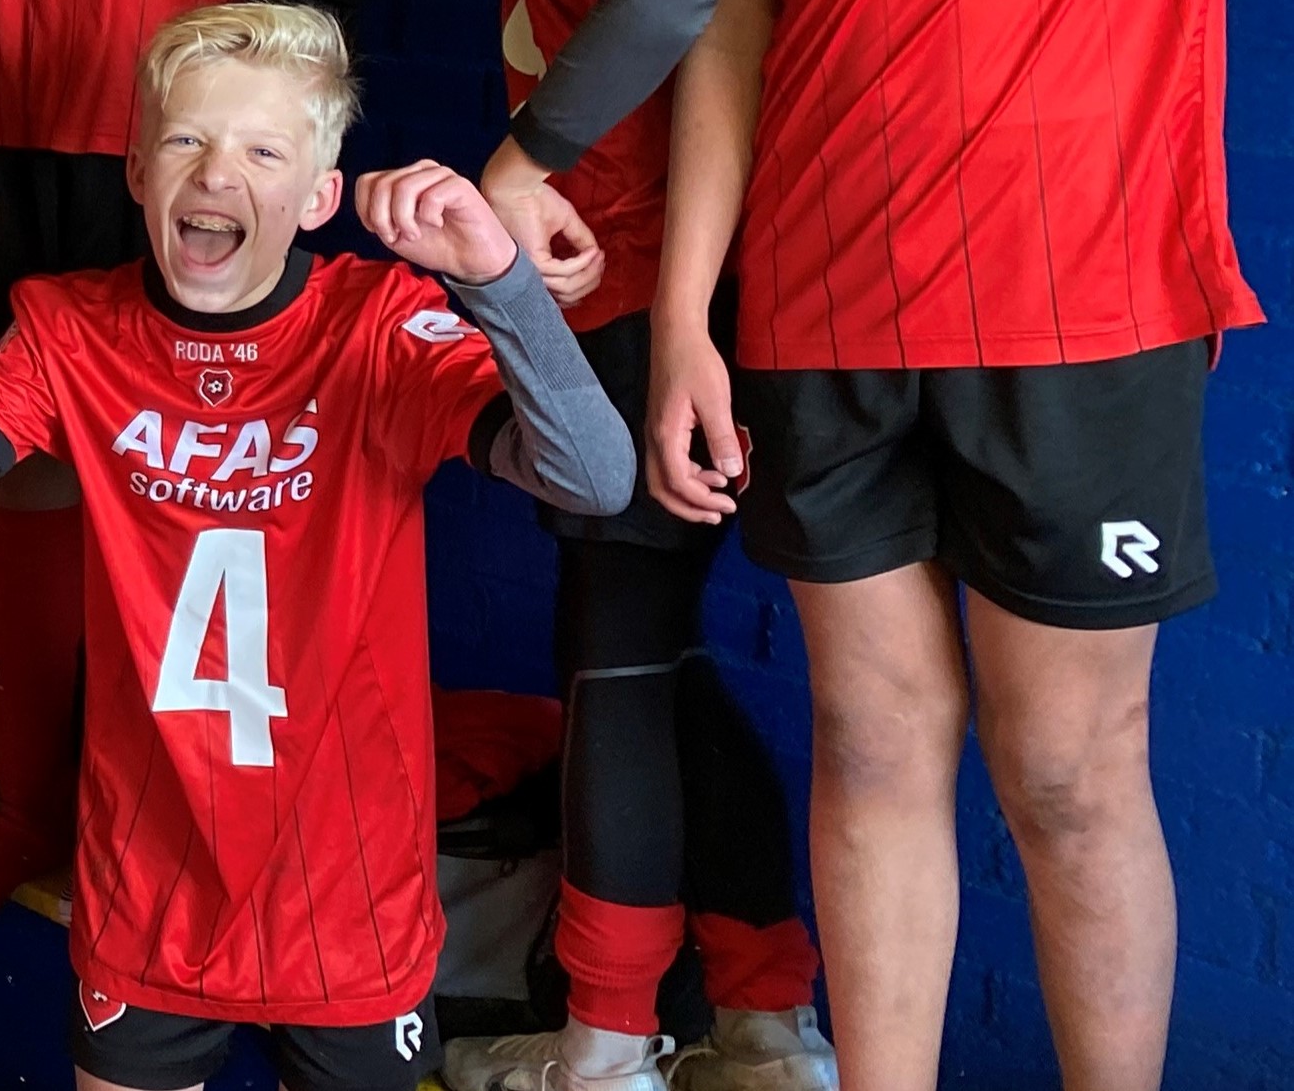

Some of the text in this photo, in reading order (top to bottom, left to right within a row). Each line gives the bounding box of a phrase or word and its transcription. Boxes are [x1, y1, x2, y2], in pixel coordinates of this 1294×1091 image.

[175, 341, 259, 363] RODA '46
[111, 398, 319, 482] AFAS
[129, 471, 314, 513] software
[152, 528, 288, 767] 4
